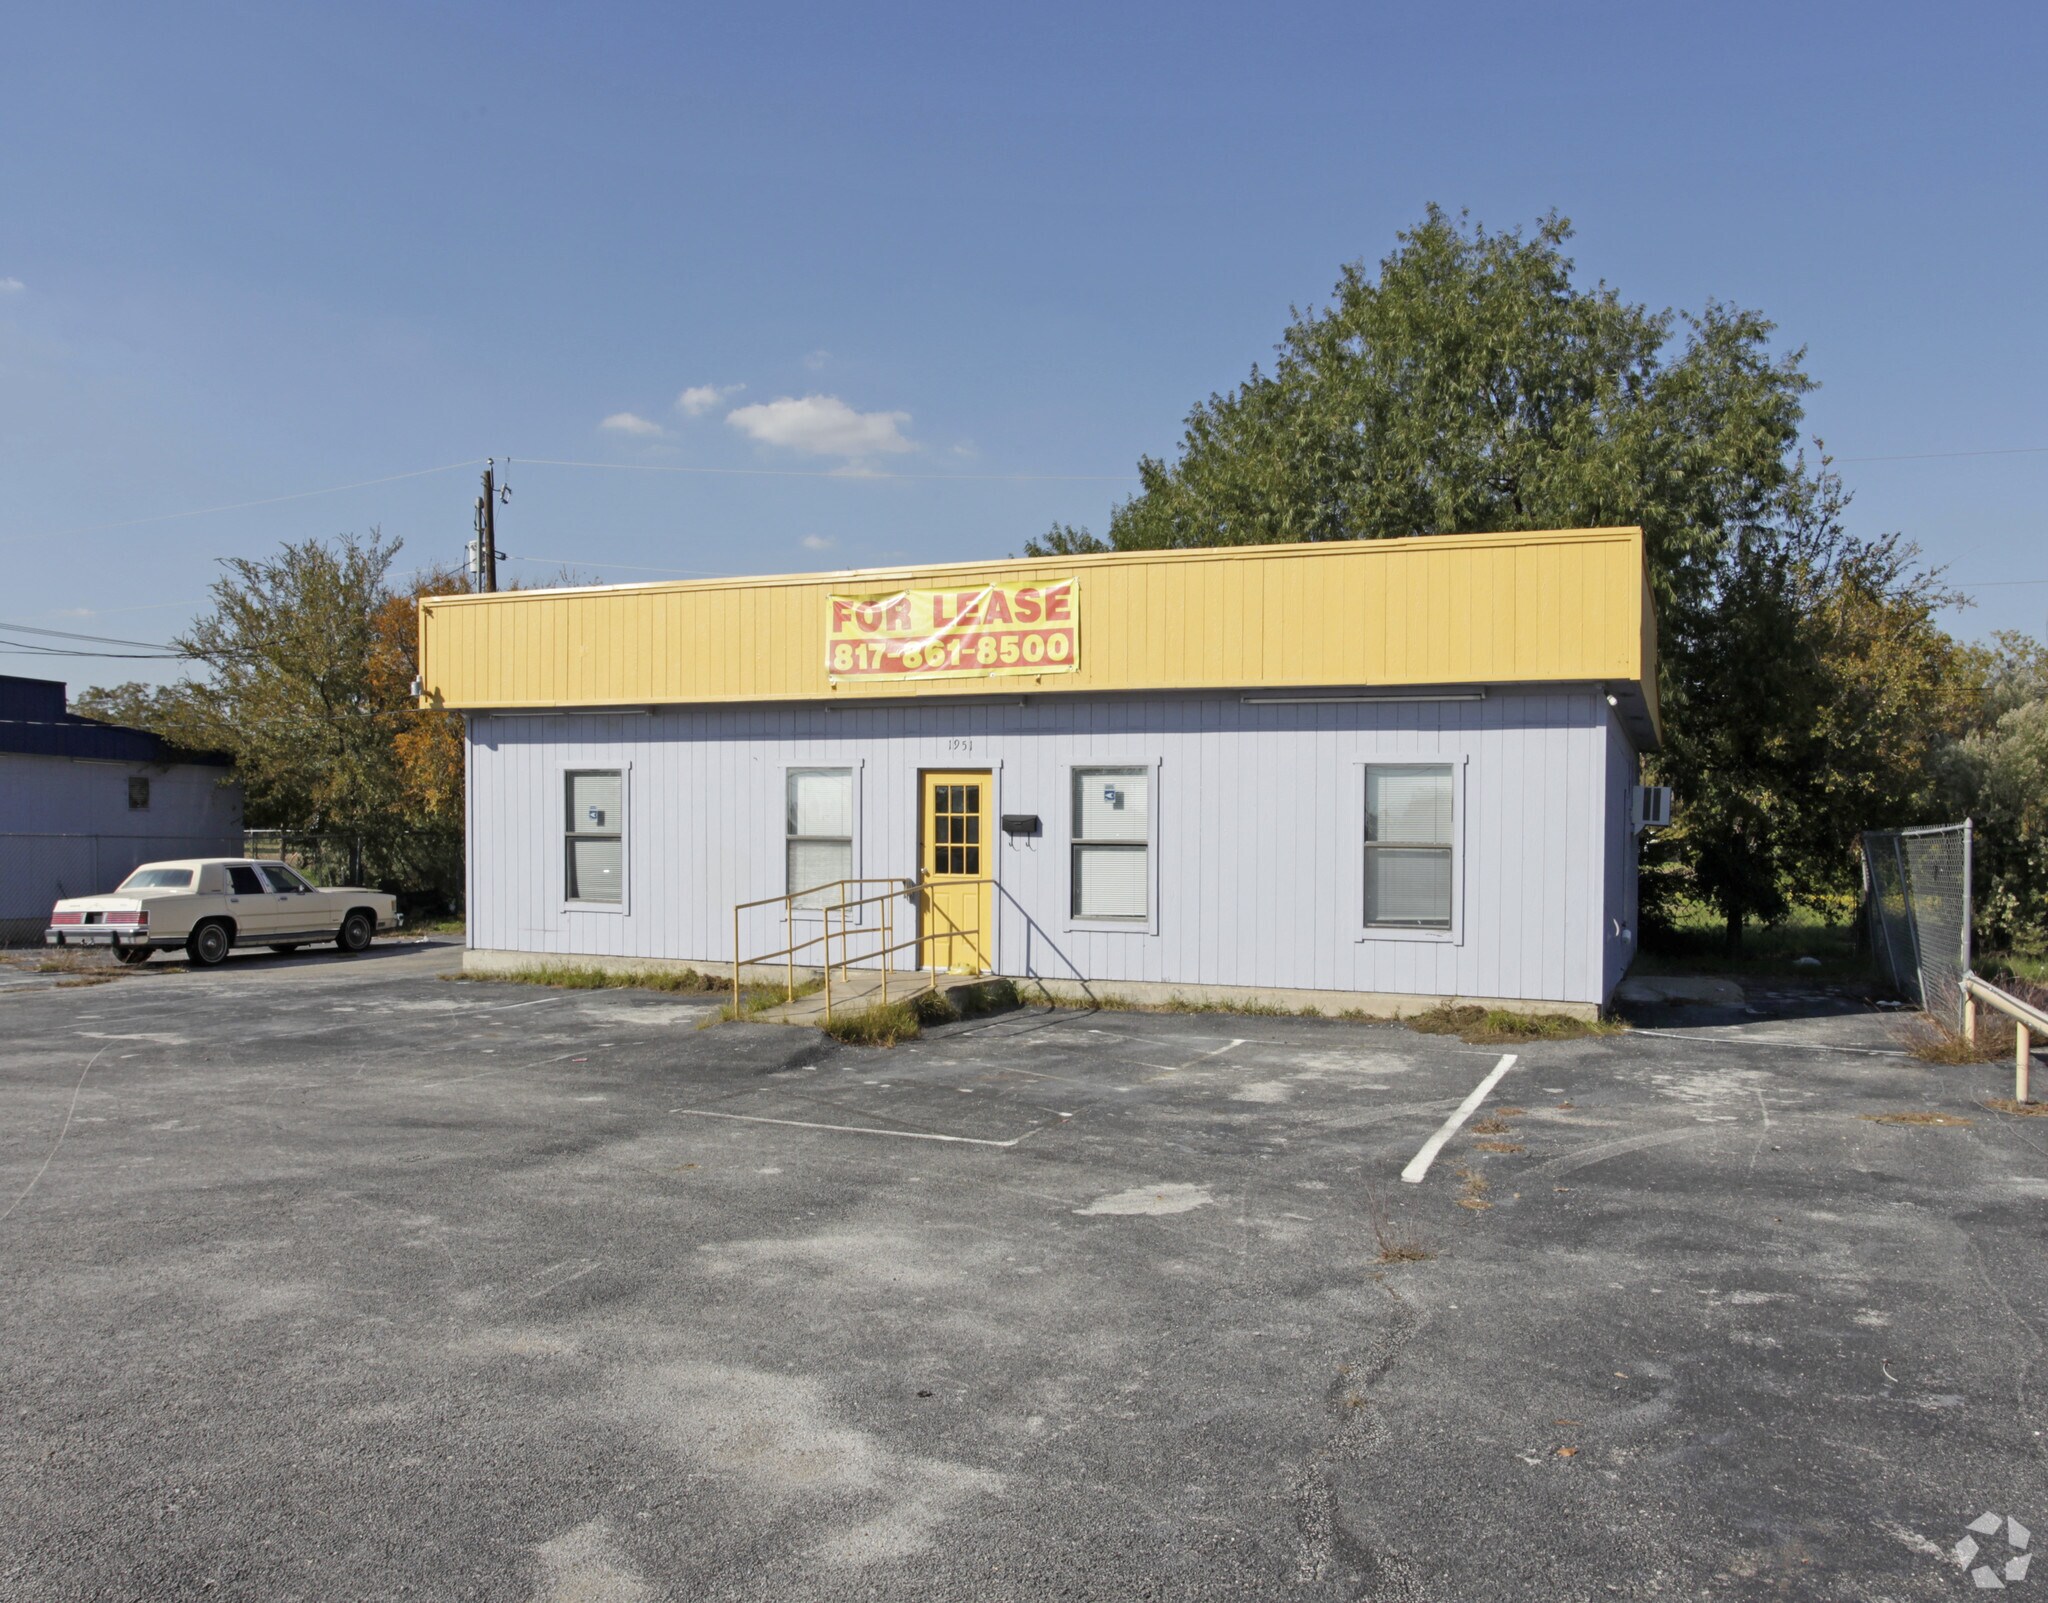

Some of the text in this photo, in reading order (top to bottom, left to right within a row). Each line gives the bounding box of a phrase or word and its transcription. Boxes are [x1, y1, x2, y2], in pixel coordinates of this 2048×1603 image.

[832, 586, 1072, 633] FOR LEASE
[833, 632, 1070, 671] 817-861-8500
[948, 739, 973, 752] 1951
